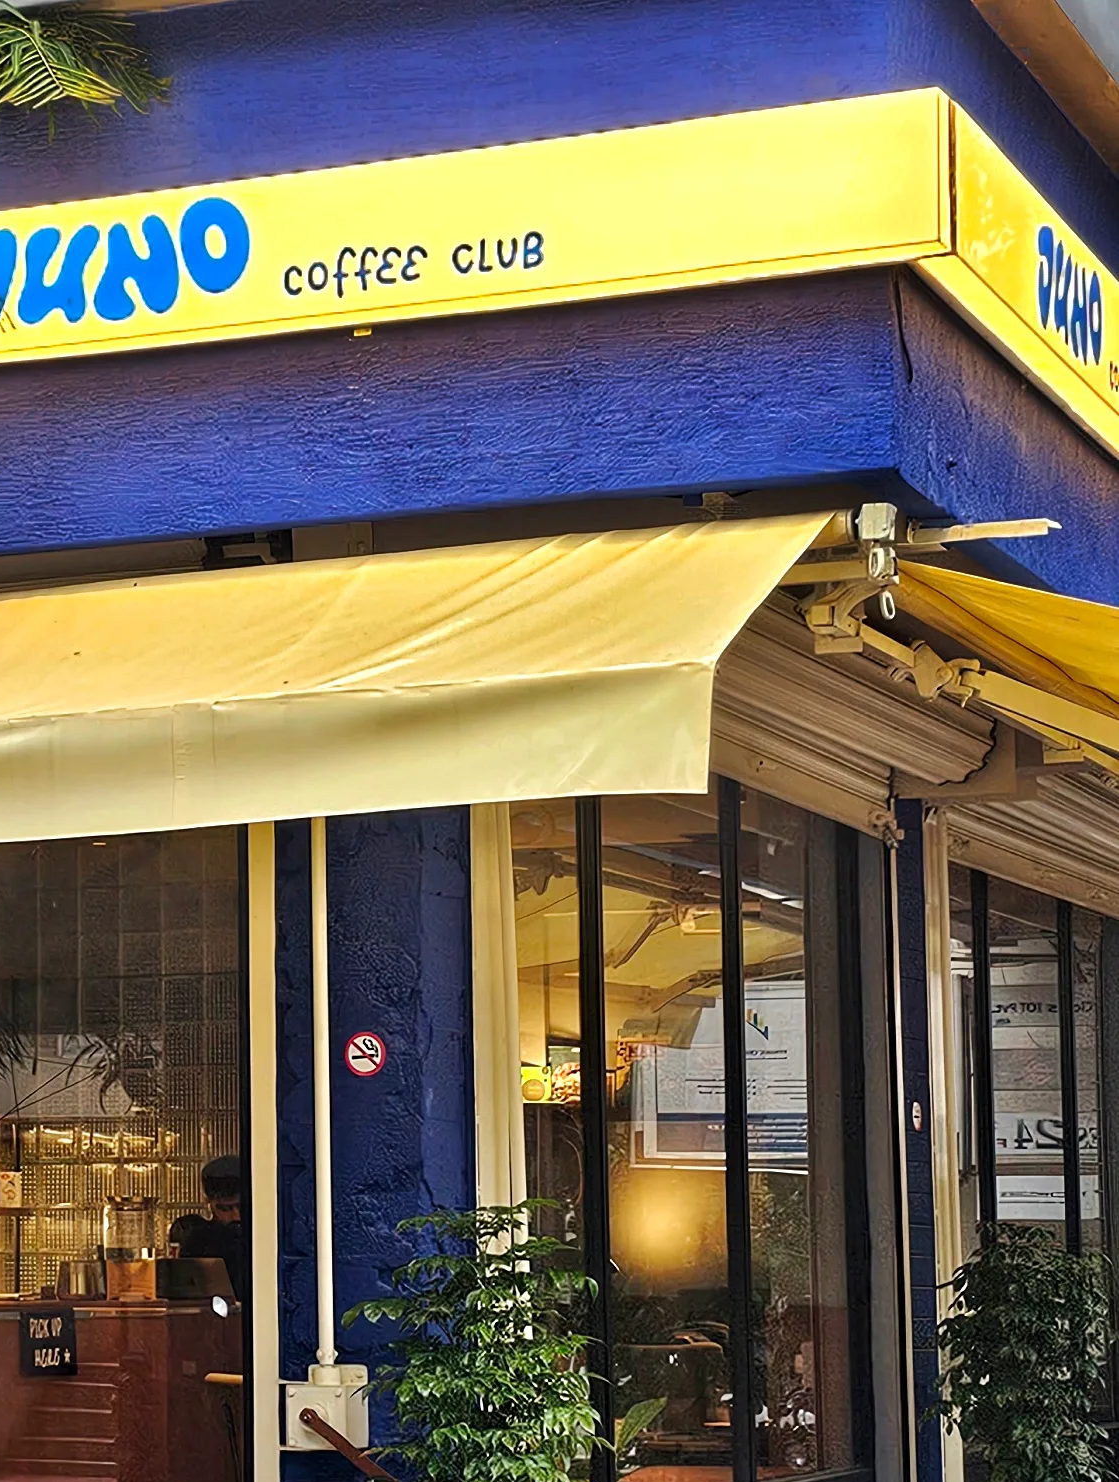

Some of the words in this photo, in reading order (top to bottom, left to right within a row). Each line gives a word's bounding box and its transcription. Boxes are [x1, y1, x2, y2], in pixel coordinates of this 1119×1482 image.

[451, 230, 544, 274] CLUB
[1038, 225, 1102, 366] JUNO
[29, 1318, 50, 1339] PICK
